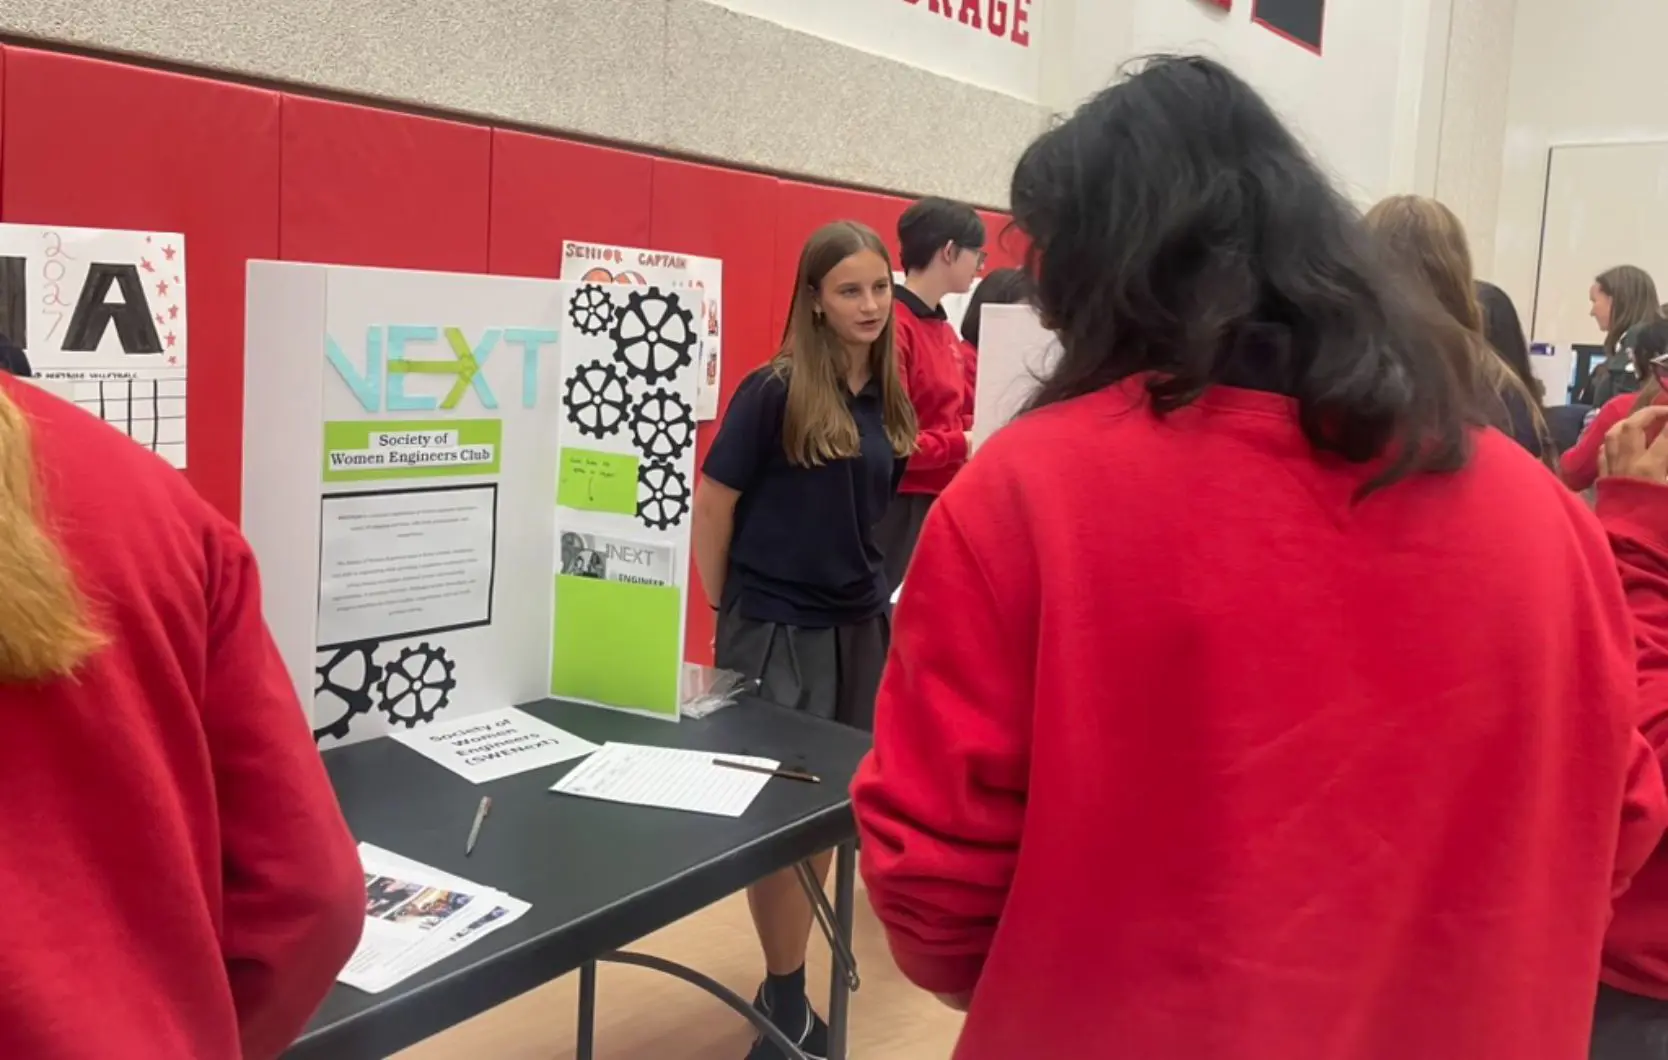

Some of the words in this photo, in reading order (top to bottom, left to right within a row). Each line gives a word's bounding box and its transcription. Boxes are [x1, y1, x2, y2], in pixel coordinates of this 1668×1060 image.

[566, 243, 623, 264] SENIOR
[638, 252, 687, 269] CAPTAIN
[325, 325, 560, 412] NEXT
[378, 433, 431, 447] Society
[434, 433, 448, 444] of
[330, 452, 384, 466] Women
[389, 450, 458, 465] Engineers
[460, 448, 490, 461] Club
[429, 725, 491, 741] Society
[495, 719, 511, 727] of
[451, 729, 518, 746] Women
[456, 733, 540, 756] Engineers
